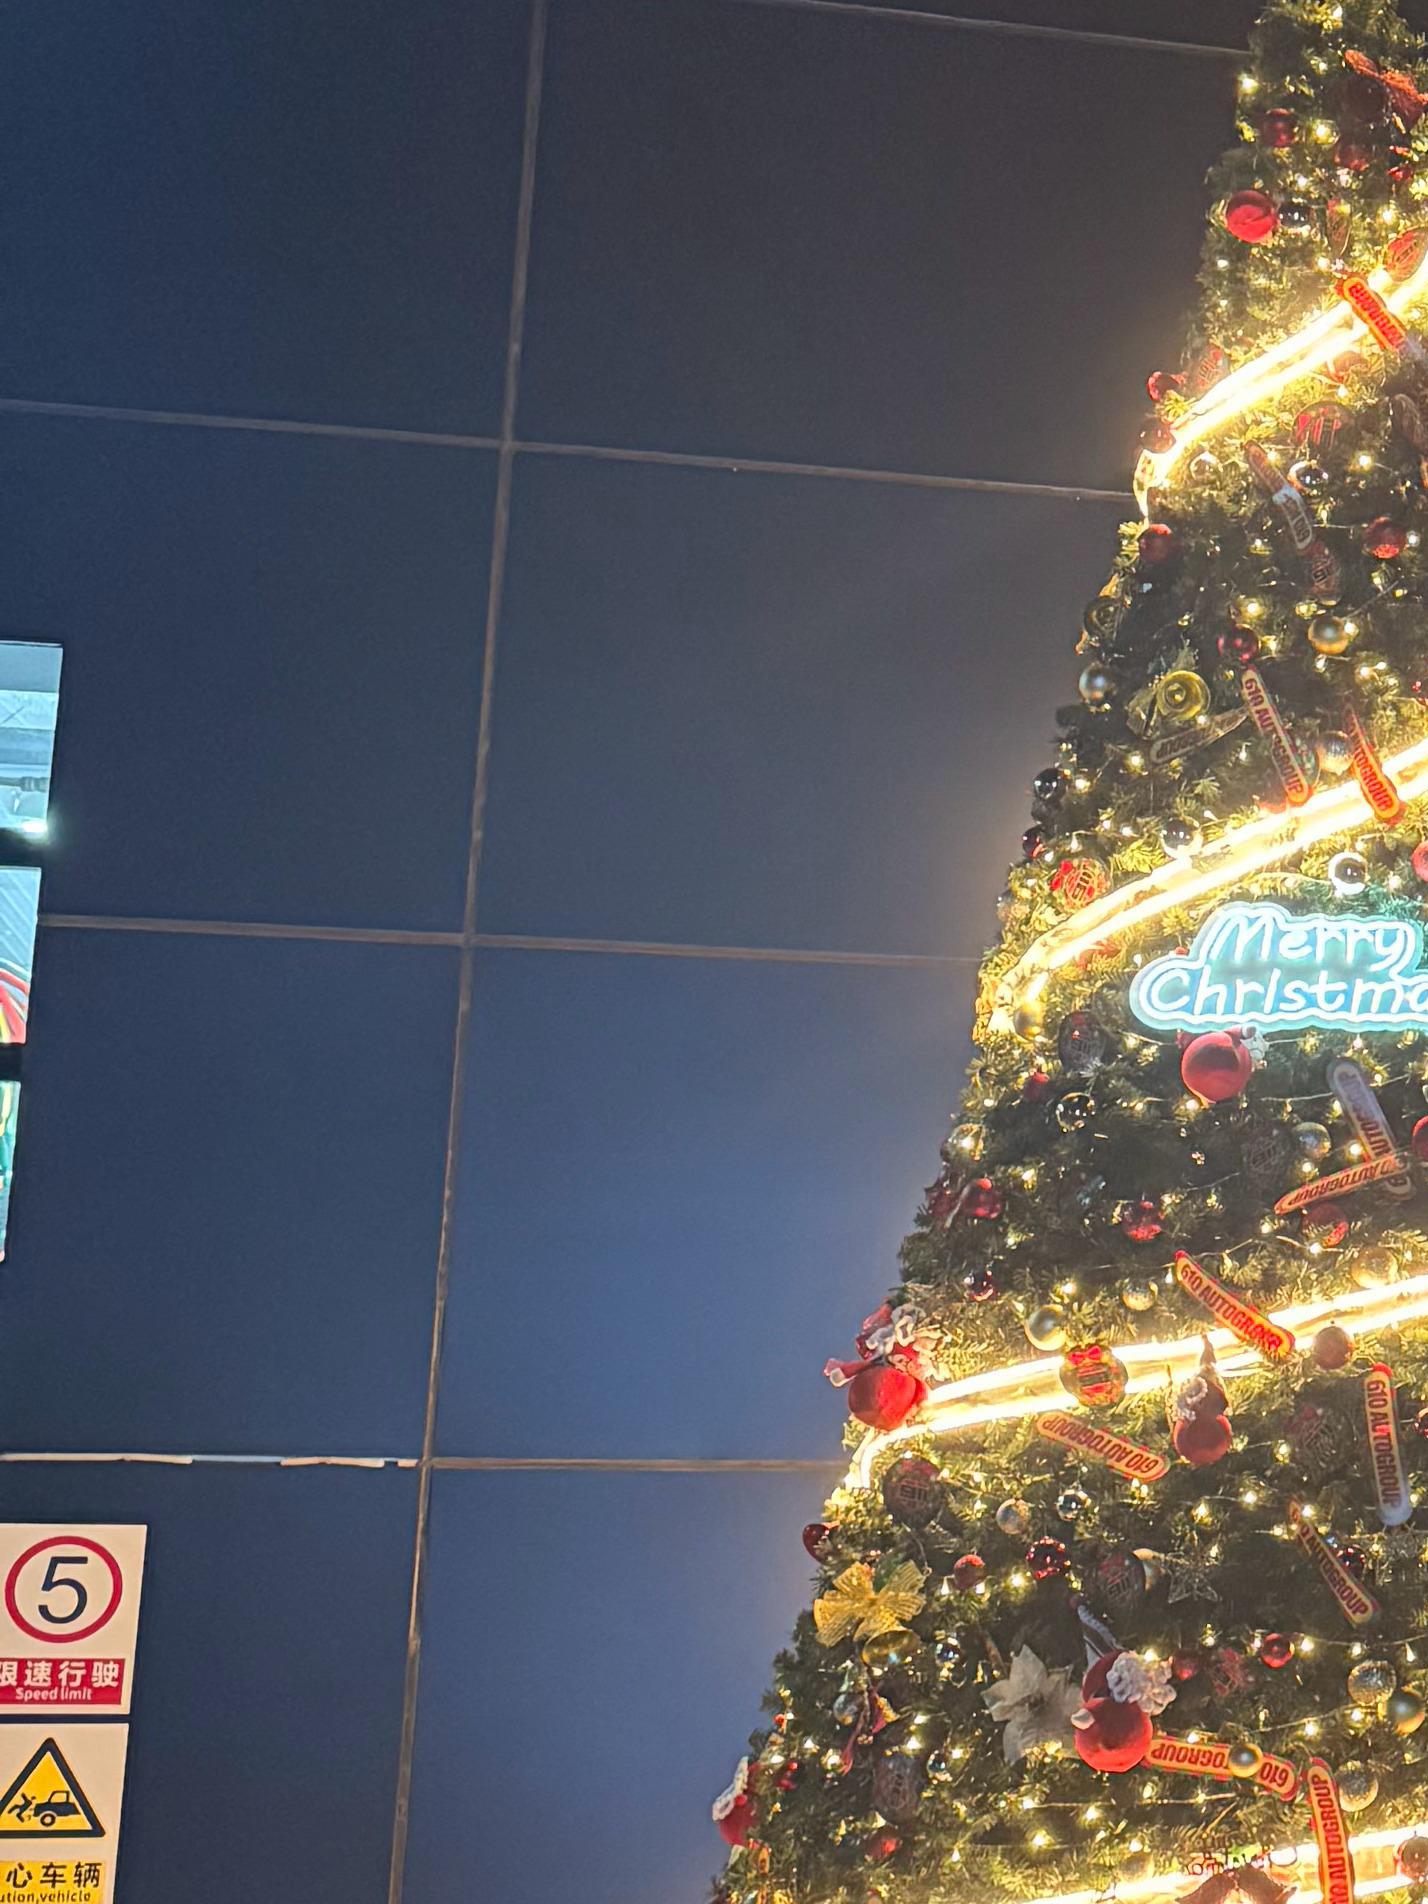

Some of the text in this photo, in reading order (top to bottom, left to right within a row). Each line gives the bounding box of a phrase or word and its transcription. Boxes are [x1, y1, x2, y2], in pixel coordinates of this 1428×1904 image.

[1212, 913, 1404, 971] Merry
[1181, 1264, 1203, 1293] 610
[1042, 1415, 1159, 1474] 610 AUTOGROUP
[1367, 1379, 1400, 1508] 610 AUTOGROUP
[38, 1556, 88, 1624] 5
[15, 1686, 92, 1702] Speed limit
[1259, 1761, 1289, 1788] 610
[1312, 1774, 1346, 1880] AUTOGROUP
